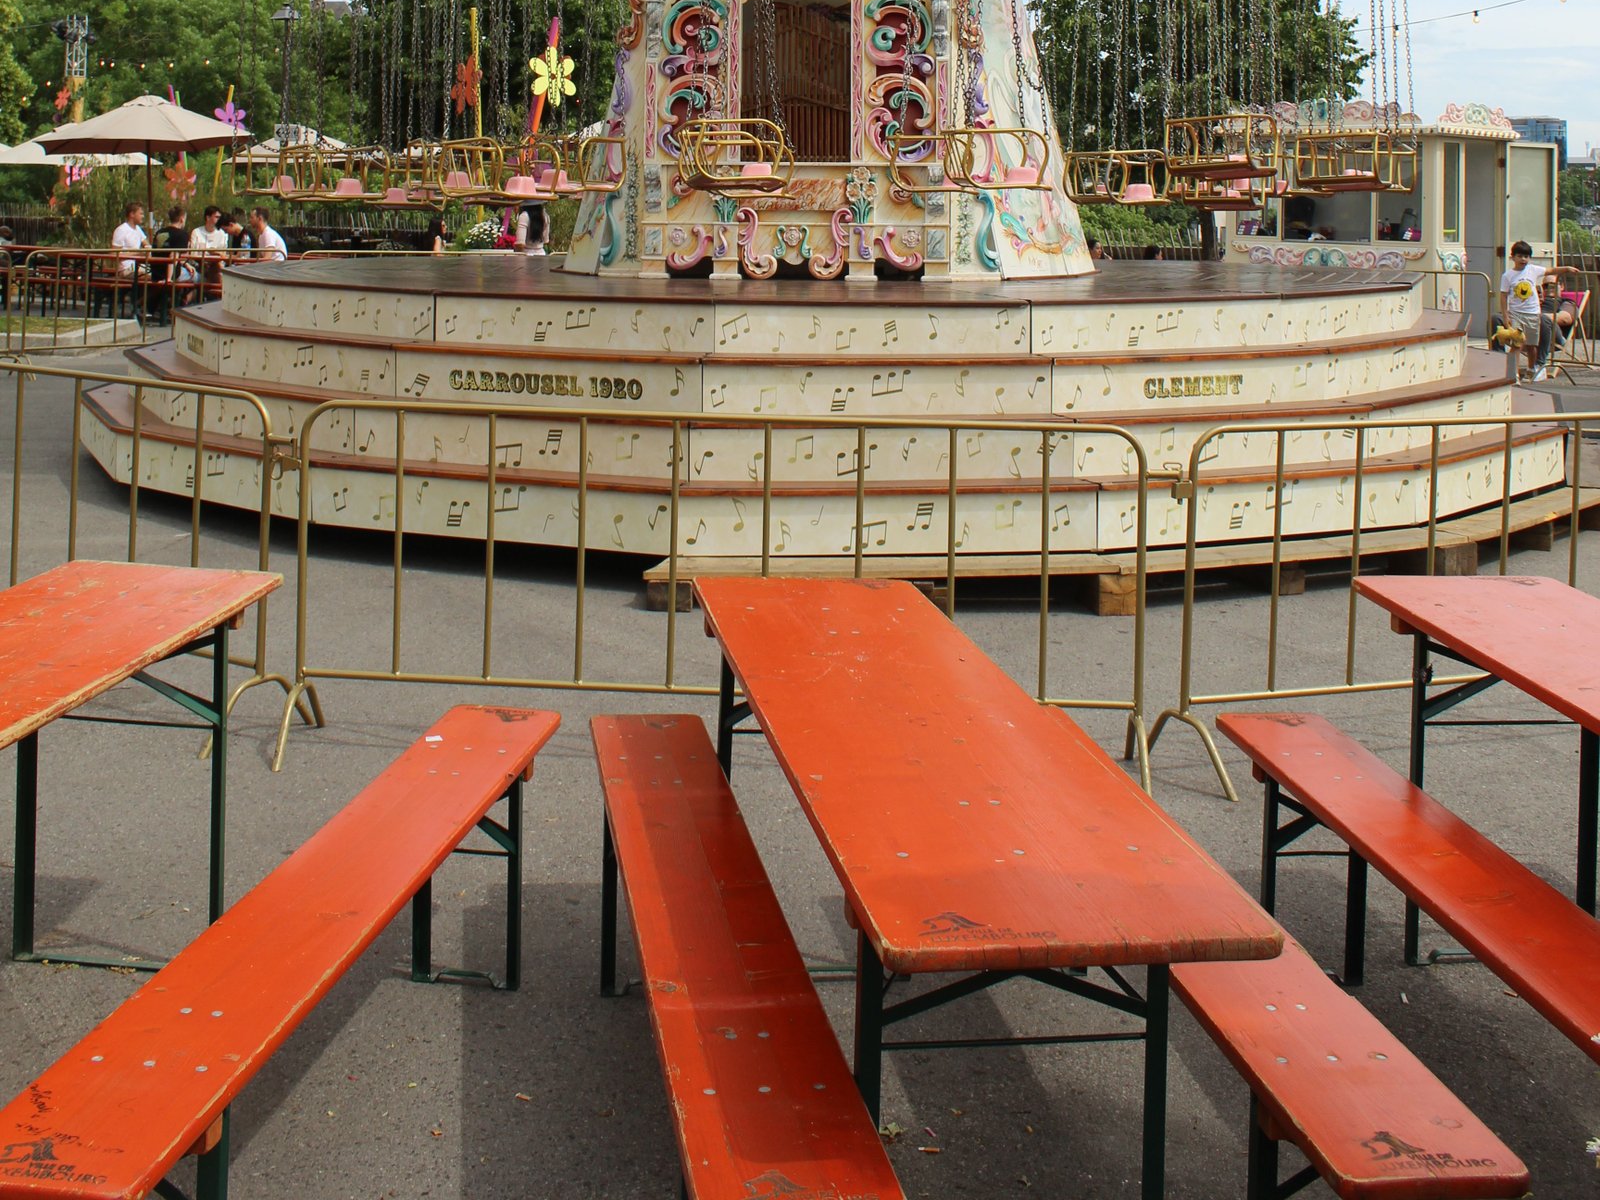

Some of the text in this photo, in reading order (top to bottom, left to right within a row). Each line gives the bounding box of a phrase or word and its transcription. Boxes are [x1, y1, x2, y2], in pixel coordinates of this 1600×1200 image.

[449, 369, 643, 400] CARROUSEL 1920
[1143, 374, 1243, 399] CLEMENT
[0, 1166, 107, 1184] XEMBOURG
